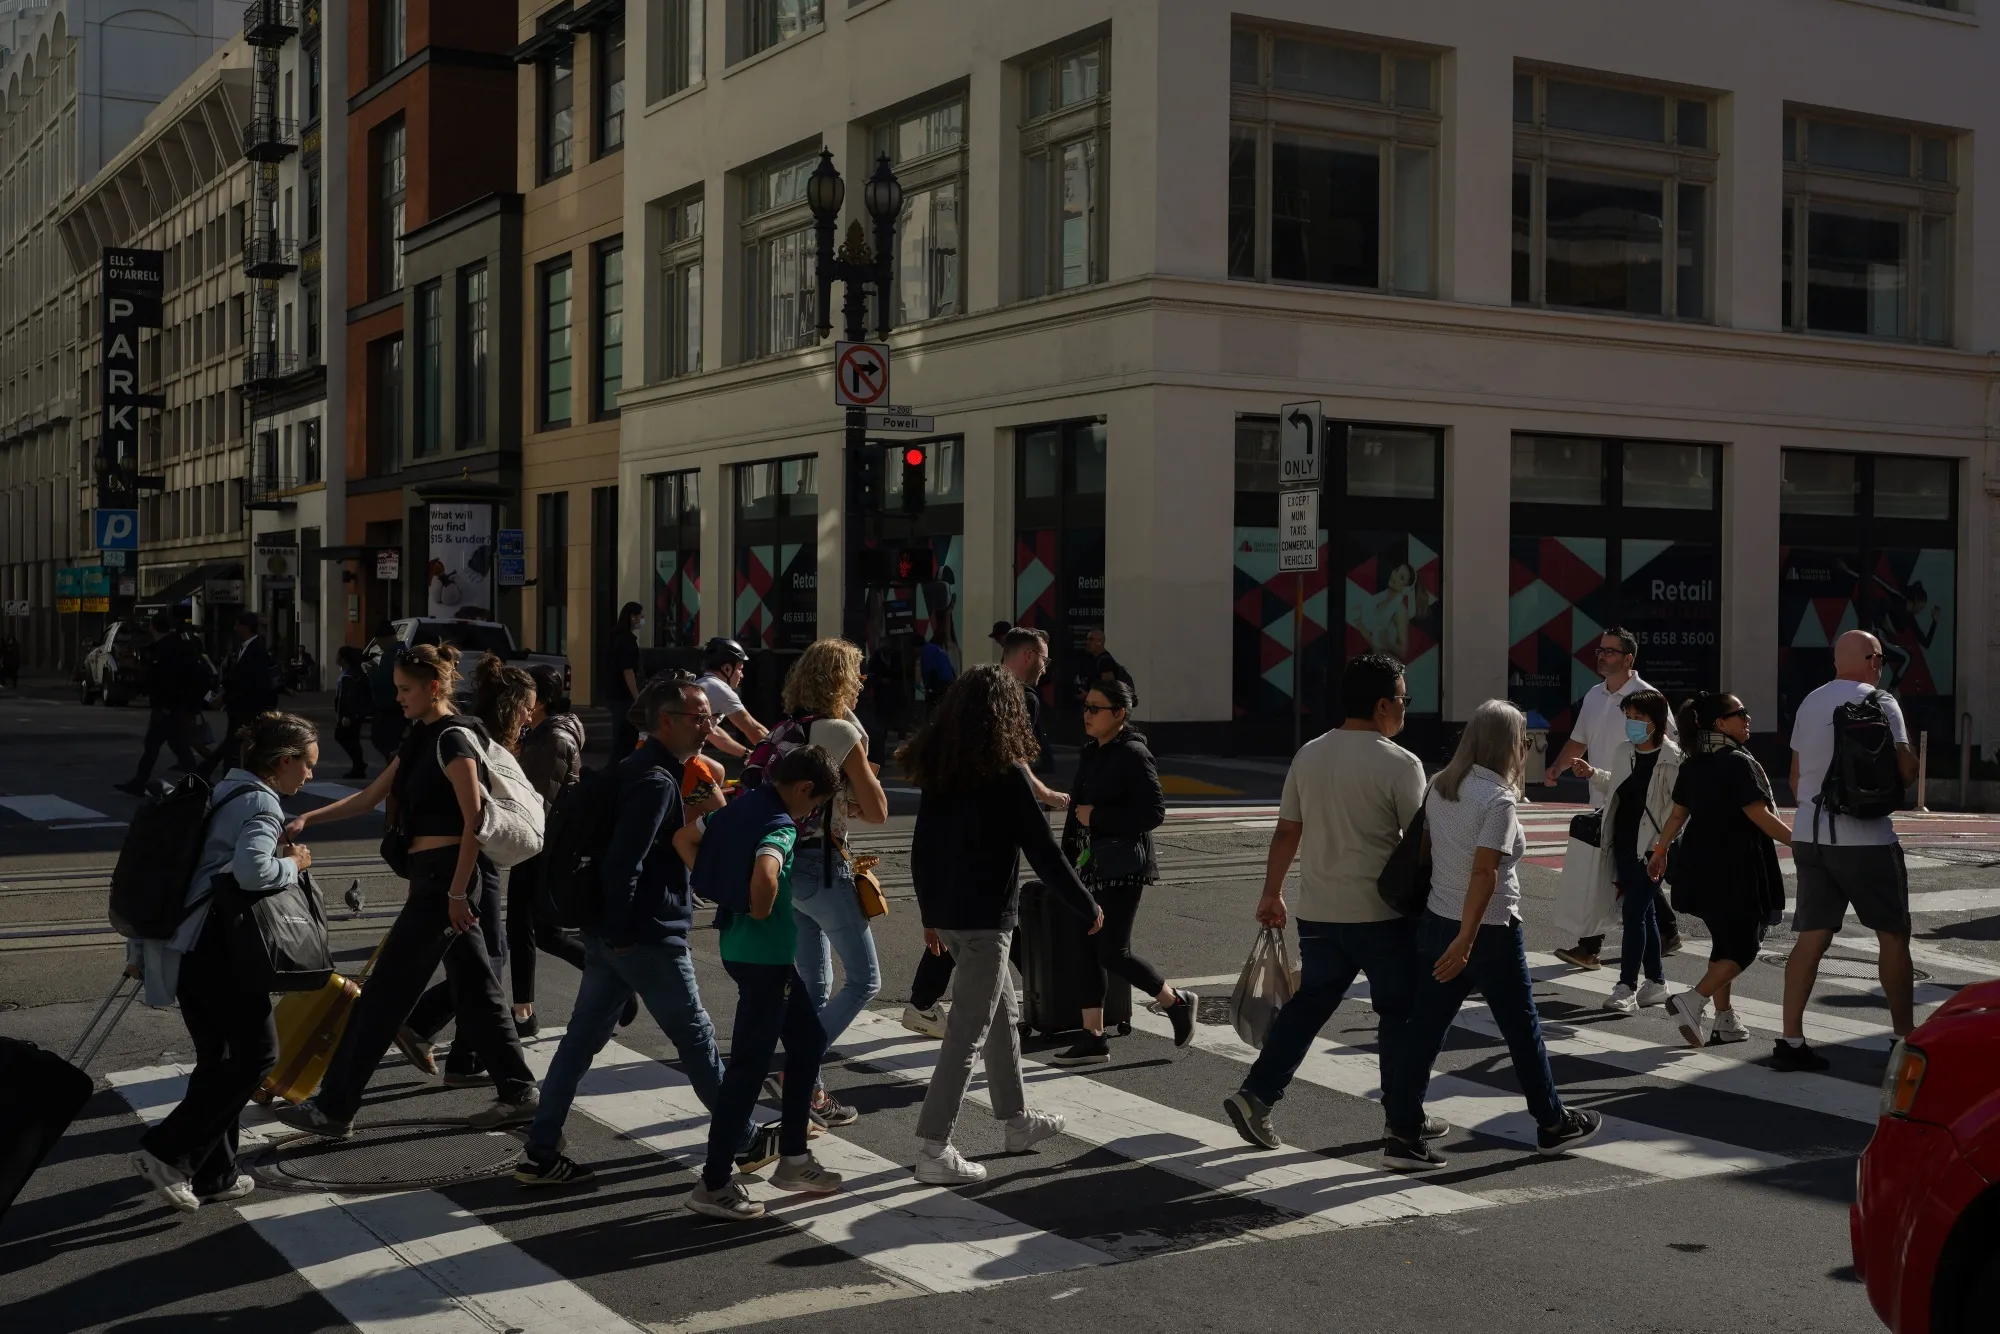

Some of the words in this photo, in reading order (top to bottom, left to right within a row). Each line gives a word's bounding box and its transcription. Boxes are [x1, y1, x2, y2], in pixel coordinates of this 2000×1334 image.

[109, 255, 135, 267] ELLS
[897, 406, 910, 414] 200
[883, 417, 919, 428] Powell
[1284, 459, 1314, 476] ONLY
[1287, 495, 1310, 507] EXCEPT
[430, 510, 453, 520] What
[454, 510, 473, 520] will
[1291, 510, 1306, 521] MUNI
[430, 524, 444, 533] you
[446, 522, 466, 532] find
[1290, 524, 1307, 536] TAXIS
[430, 533, 443, 545] $15
[445, 534, 453, 543] &
[455, 534, 492, 545] under?
[1281, 540, 1315, 552] COMMERCIAL
[1284, 554, 1313, 566] VEHICLES
[792, 571, 817, 589] Retai
[1077, 575, 1105, 589] Retail
[1651, 579, 1713, 602] Retail
[782, 612, 793, 623] 415
[793, 612, 805, 623] 658
[805, 612, 817, 623] 360
[1652, 631, 1677, 645] 658
[1681, 631, 1715, 645] 3600
